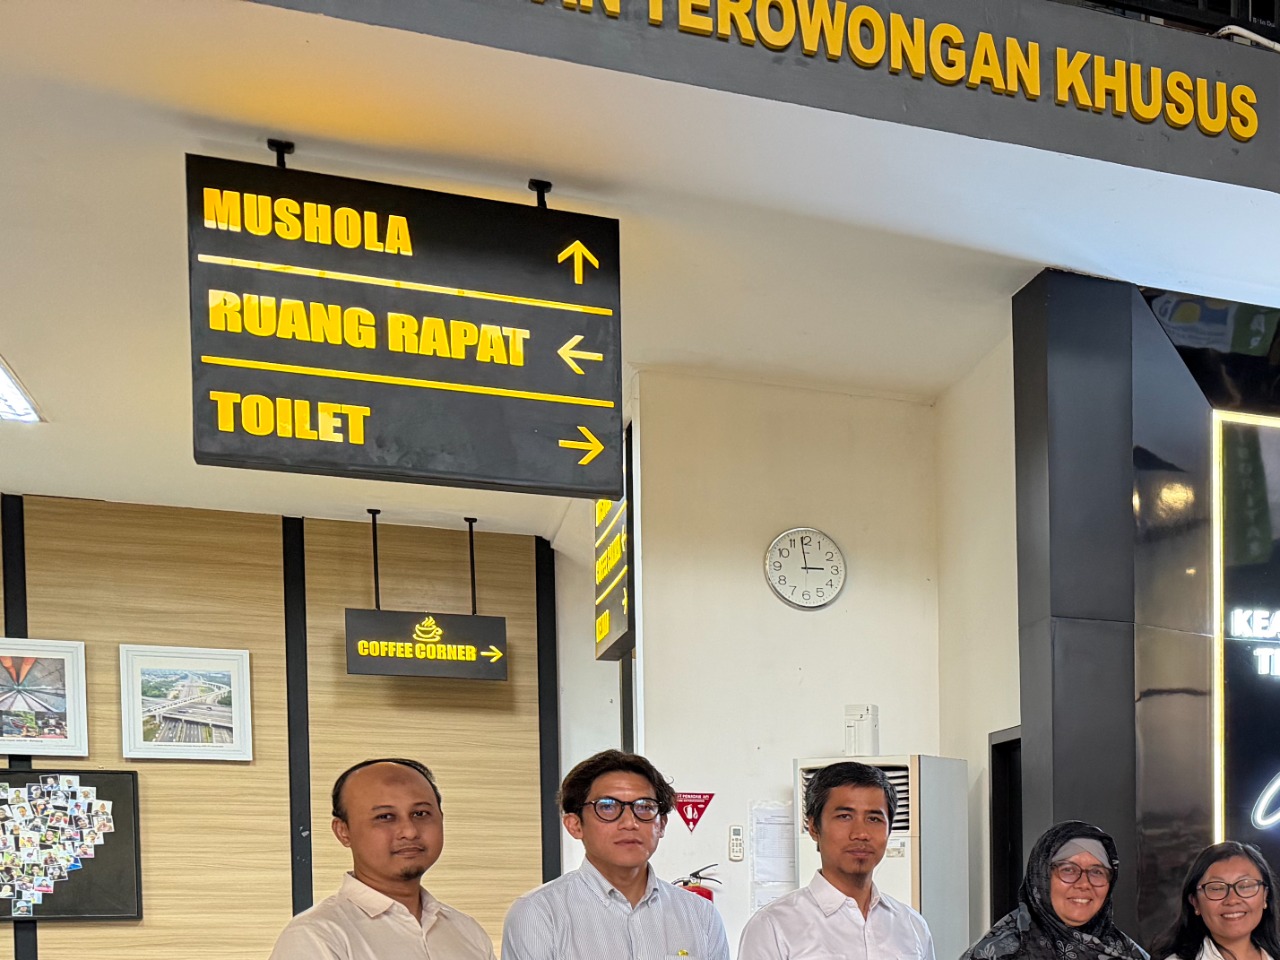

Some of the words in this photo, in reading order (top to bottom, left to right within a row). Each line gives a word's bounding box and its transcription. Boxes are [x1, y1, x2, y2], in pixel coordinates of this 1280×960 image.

[1055, 46, 1258, 142] KHUSUS
[203, 187, 413, 256] MUSHOLA
[208, 289, 376, 350] RUANG
[388, 311, 530, 367] RAPAT
[210, 390, 371, 445] TOILET
[778, 547, 790, 559] 10
[825, 551, 834, 562] 2
[772, 560, 782, 571] 9
[830, 565, 839, 575] 3
[778, 575, 787, 585] 8
[825, 578, 834, 588] 4
[789, 585, 797, 596] 7
[801, 590, 811, 601] 6
[816, 587, 825, 598] 5
[357, 640, 414, 658] COFFEE
[414, 642, 477, 662] CORNER
